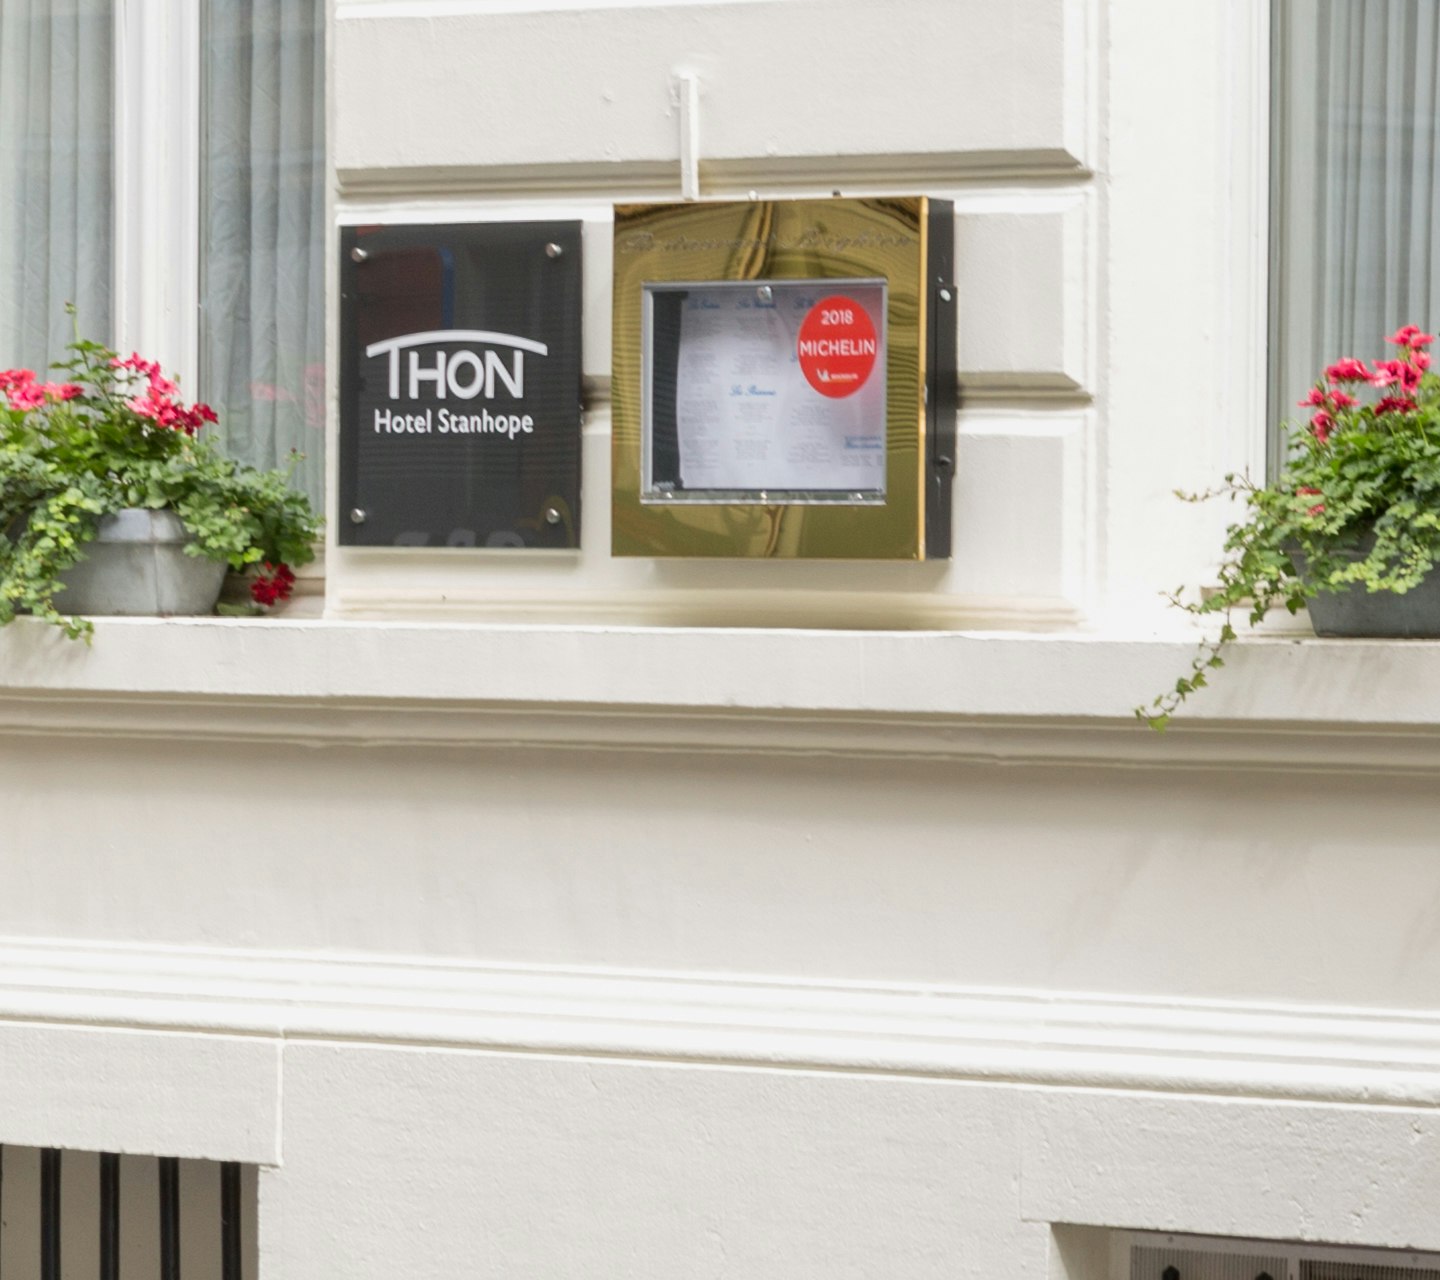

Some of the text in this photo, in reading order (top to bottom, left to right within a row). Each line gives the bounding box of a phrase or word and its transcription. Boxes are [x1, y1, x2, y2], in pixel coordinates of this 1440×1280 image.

[821, 309, 854, 326] 2018
[799, 339, 876, 357] MICHELIN
[366, 329, 549, 400] THON
[374, 407, 534, 441] Hotel Stanhope
